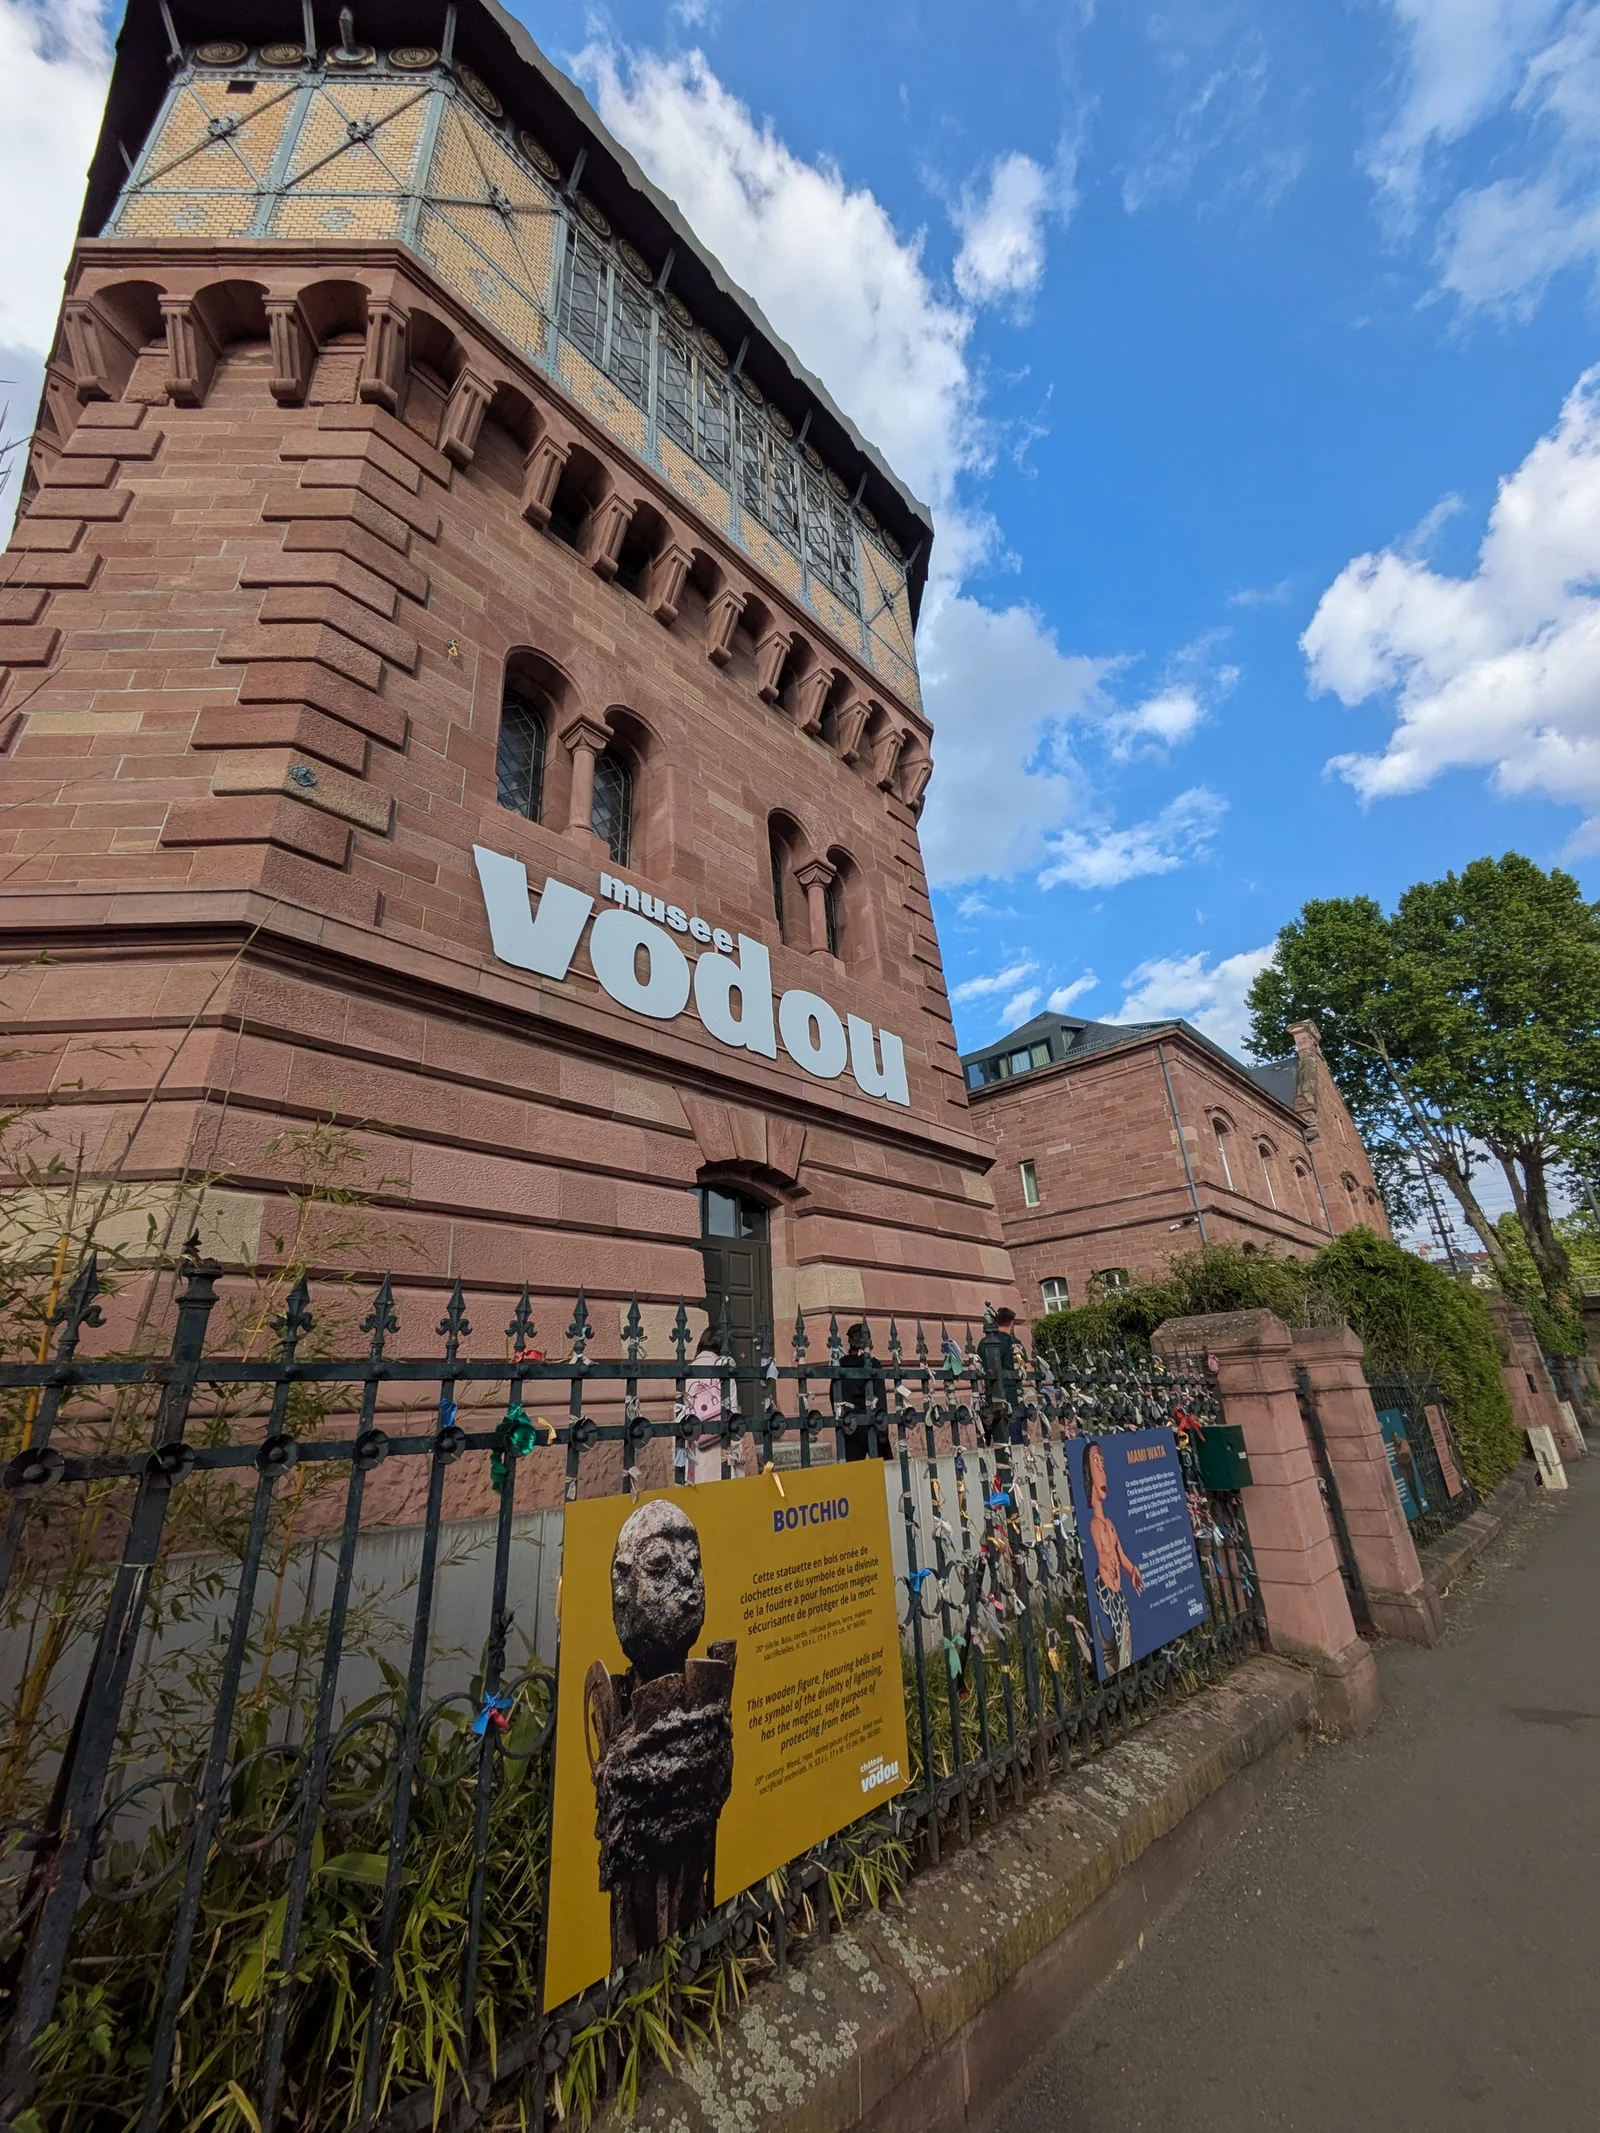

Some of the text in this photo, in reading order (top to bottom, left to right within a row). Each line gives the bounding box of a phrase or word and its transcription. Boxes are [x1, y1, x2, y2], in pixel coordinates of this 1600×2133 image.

[600, 872, 733, 953] musee
[472, 844, 910, 1107] vodou
[1126, 1445, 1166, 1464] MAMI WATA
[773, 1497, 849, 1533] BOTCHIO
[740, 1556, 879, 1604] clochettes et du symbole de la divinité
[753, 1546, 868, 1584] Cette statuette en bois ornée de
[744, 1572, 878, 1620] de la foudre a pour fonction magique
[748, 1587, 876, 1636] sécurisante de protéger de la mort.
[747, 1646, 884, 1712] This wooden figure, featuring bells and
[749, 1716, 762, 1730] the
[764, 1700, 792, 1724] symbol
[794, 1696, 802, 1712] of
[804, 1692, 816, 1706] the
[818, 1681, 844, 1700] divinity
[845, 1675, 852, 1690] of
[761, 1727, 776, 1742] has
[777, 1720, 790, 1734] the
[825, 1698, 840, 1713] safe
[841, 1686, 868, 1709] purpose
[869, 1680, 876, 1695] of
[780, 1704, 862, 1755] protecting from death.
[860, 1755, 884, 1772] château
[861, 1760, 899, 1793] vodou
